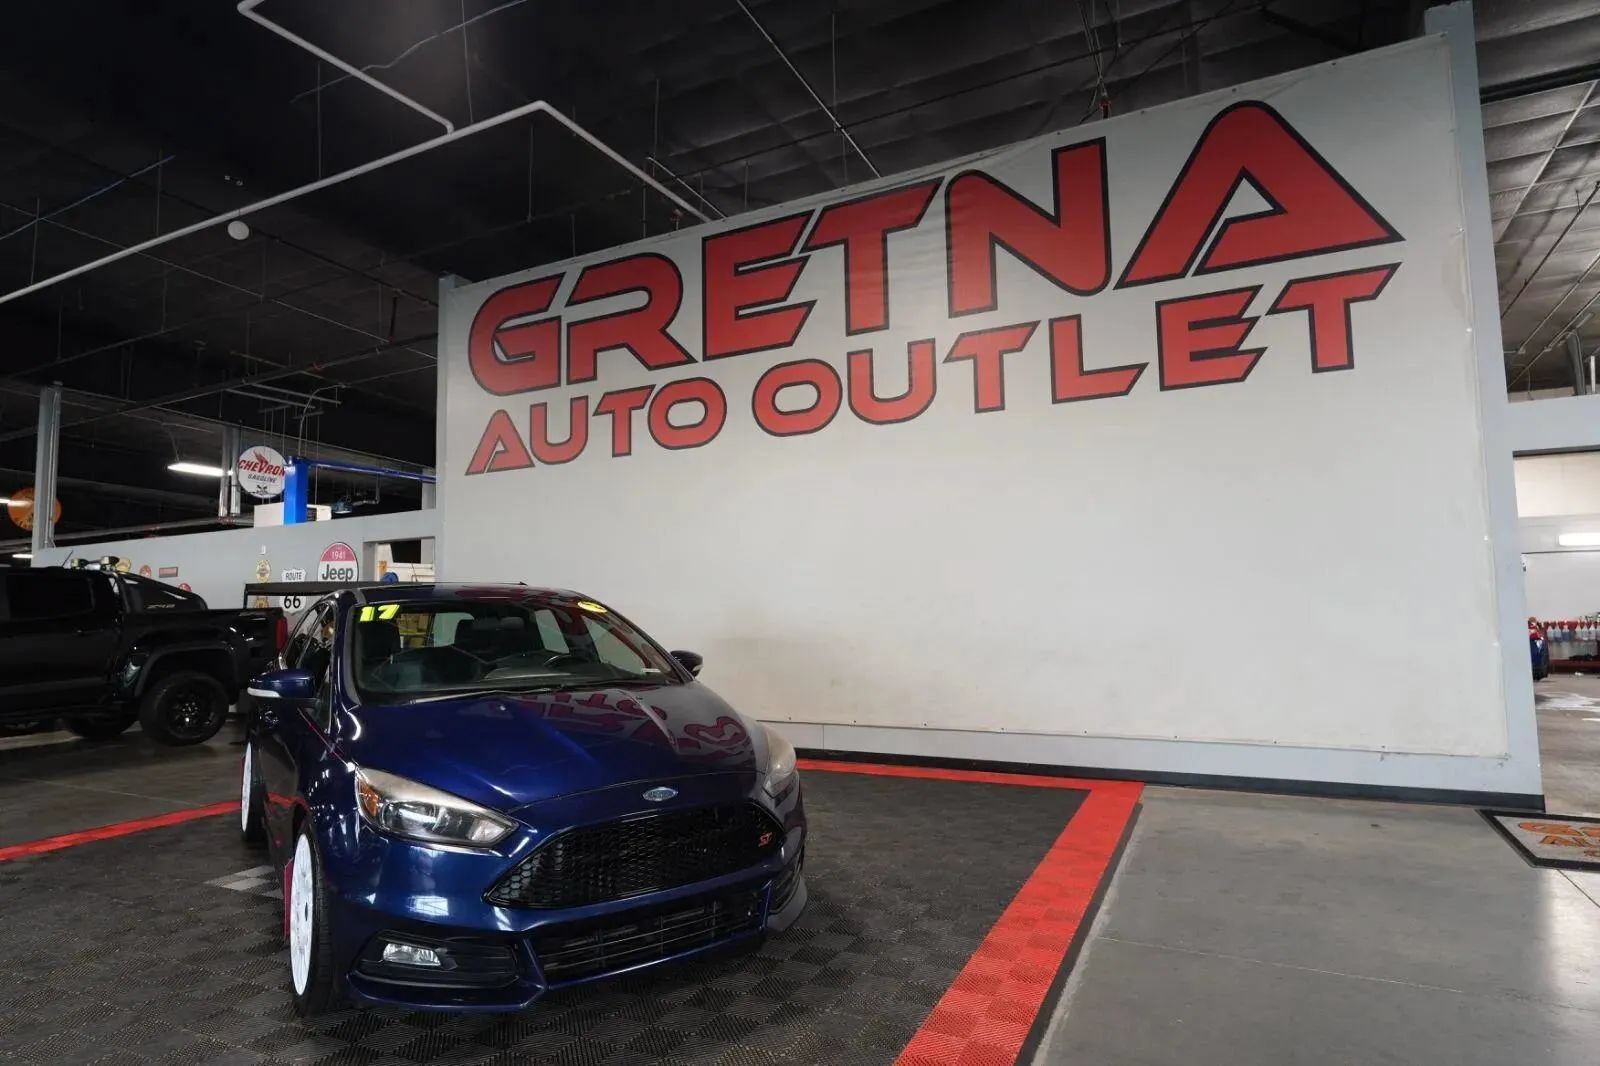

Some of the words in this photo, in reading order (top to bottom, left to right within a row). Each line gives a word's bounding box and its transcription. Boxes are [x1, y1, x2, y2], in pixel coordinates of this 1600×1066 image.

[467, 99, 1406, 396] GRETNA
[464, 376, 728, 476] AUTO
[752, 262, 1402, 437] OUTLET
[239, 459, 286, 476] CHEVRON
[248, 473, 277, 484] GASOLINE
[331, 551, 346, 560] 1941
[286, 572, 302, 580] ROUTE
[322, 564, 354, 582] Jeep
[283, 594, 301, 609] 66
[359, 604, 400, 622] 17
